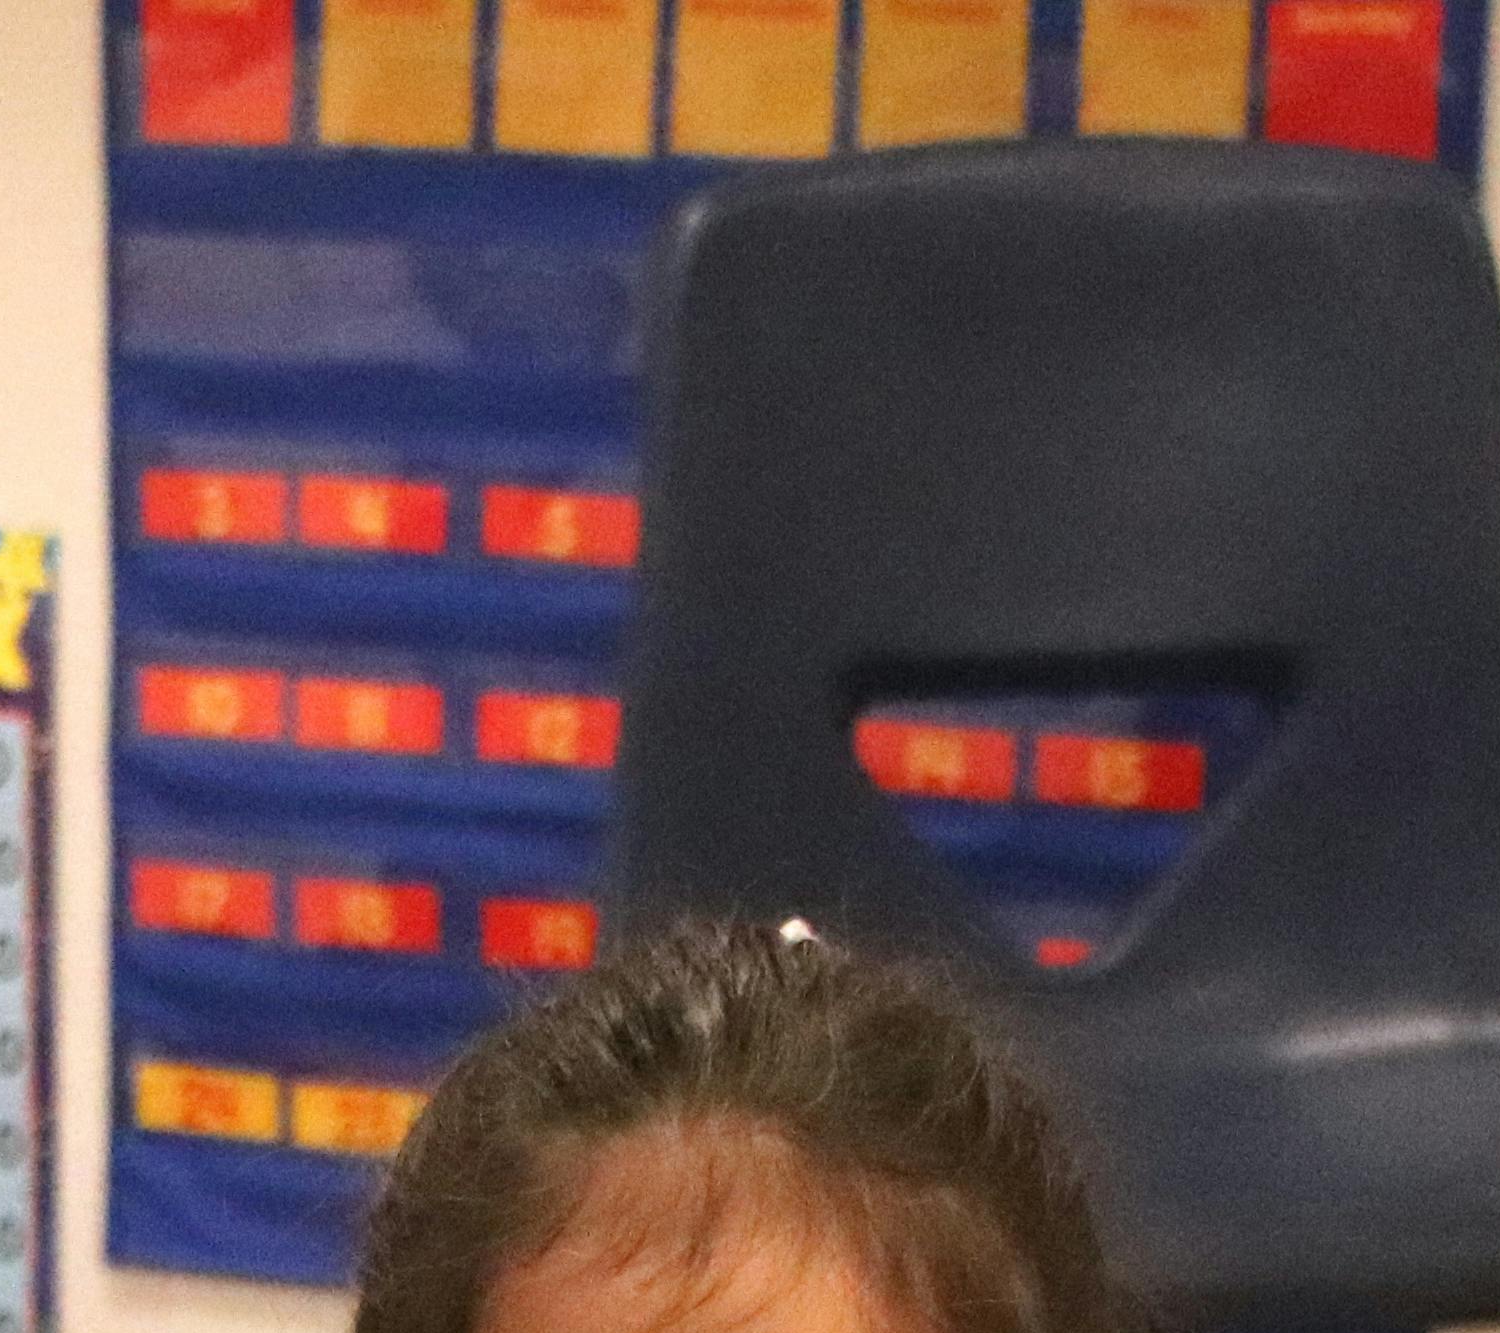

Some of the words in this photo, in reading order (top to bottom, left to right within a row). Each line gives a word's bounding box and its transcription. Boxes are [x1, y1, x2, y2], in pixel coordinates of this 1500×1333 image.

[196, 482, 231, 539] 3
[543, 494, 579, 557] 5
[1089, 740, 1142, 808] 15
